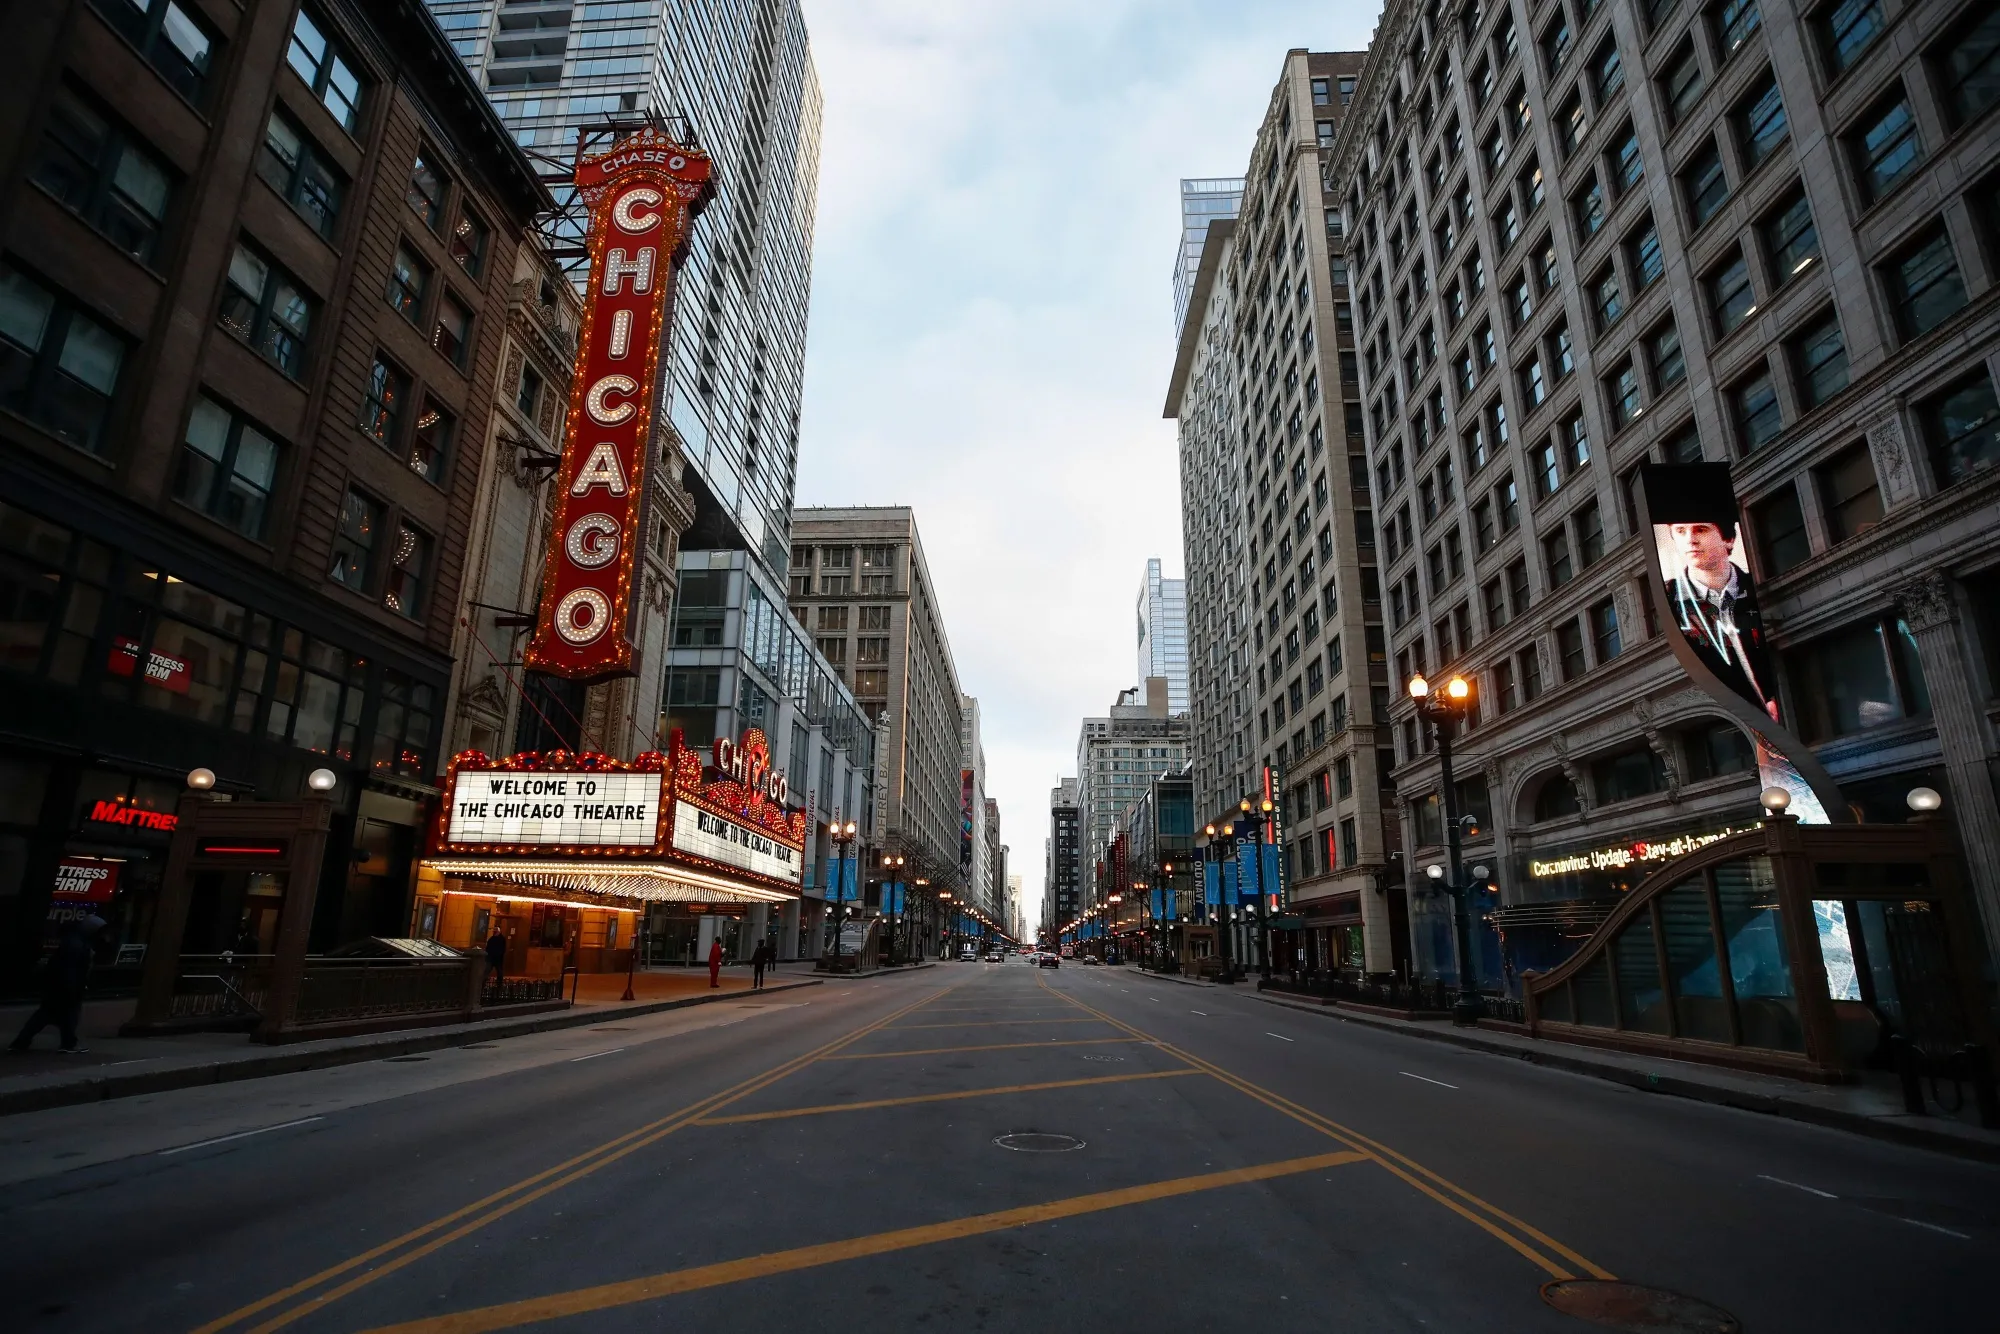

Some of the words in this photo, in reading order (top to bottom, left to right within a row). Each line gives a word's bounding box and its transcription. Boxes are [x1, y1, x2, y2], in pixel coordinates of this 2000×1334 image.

[601, 150, 669, 173] CHASE
[554, 188, 663, 647] CHICAGO
[879, 728, 890, 778] BALLET
[490, 779, 567, 796] WELCOME
[576, 780, 597, 796] TO
[1271, 770, 1280, 801] GENE
[459, 802, 488, 818] THE
[494, 803, 564, 819] CHICAGO
[573, 804, 646, 820] THEATRE
[806, 788, 816, 837] Walgreens
[876, 784, 888, 848] JOFFREY
[697, 810, 728, 840] WELCOME
[730, 824, 738, 844] TO
[740, 828, 749, 848] THE
[751, 834, 772, 856] CHICAGO
[774, 842, 792, 863] THEATRE
[1274, 805, 1283, 853] SISKEL
[1193, 860, 1203, 877] OLD
[1591, 848, 1635, 871] Update:
[1194, 878, 1204, 904] NAVY
